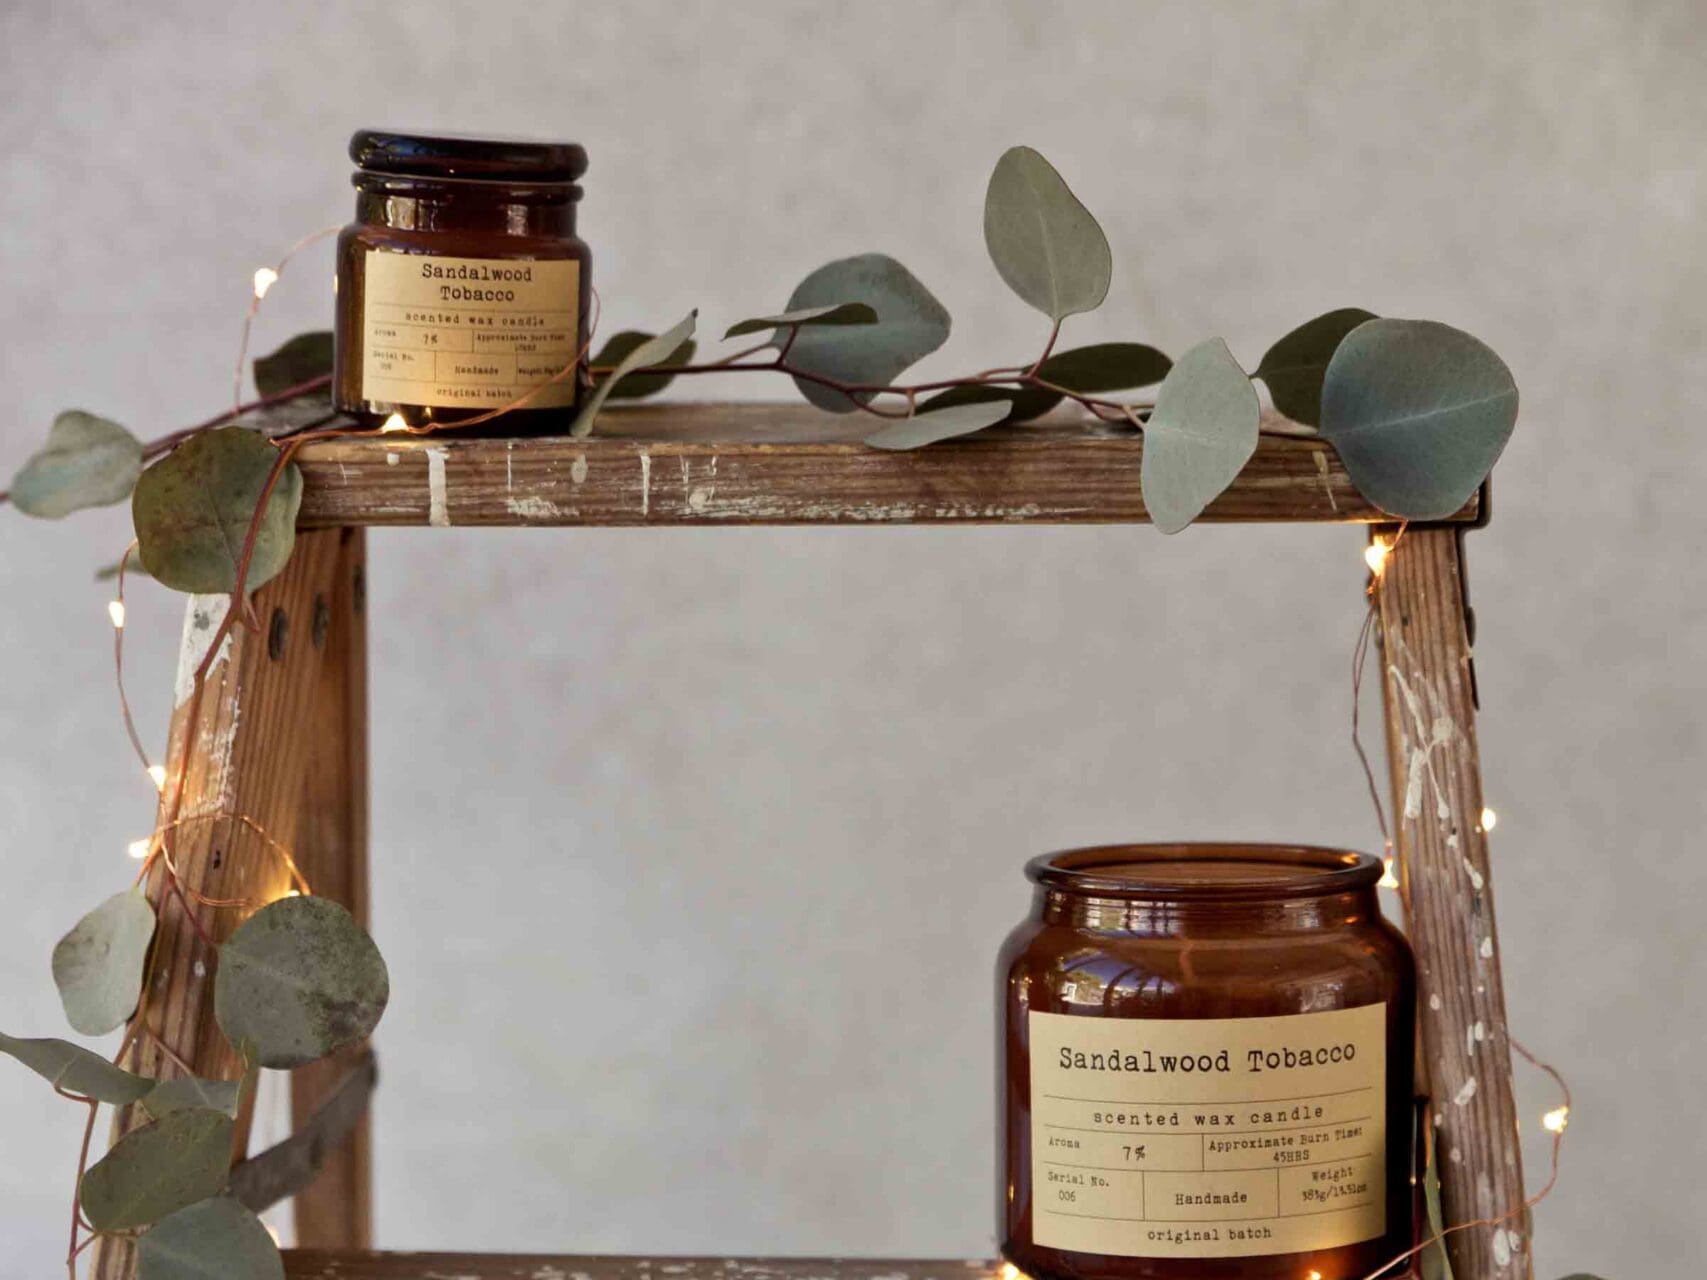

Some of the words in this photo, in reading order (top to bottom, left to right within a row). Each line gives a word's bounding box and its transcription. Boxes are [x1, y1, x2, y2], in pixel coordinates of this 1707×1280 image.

[422, 263, 532, 282] Sandalwood
[440, 286, 515, 301] Tobacco
[405, 312, 459, 324] scented
[469, 316, 493, 326] wax
[502, 315, 544, 327] candle
[1059, 1046, 1231, 1073] Sandalwood
[1247, 1042, 1356, 1073] Tobacco
[1094, 1111, 1180, 1127] scented
[1195, 1113, 1236, 1126] wax
[1250, 1106, 1324, 1124] candle
[1048, 1137, 1080, 1149] Aroma
[1208, 1135, 1294, 1153] Approximate
[1300, 1133, 1330, 1146] Burn
[1122, 1145, 1146, 1161] 7%
[1272, 1149, 1310, 1164] 45HRS
[1048, 1170, 1085, 1186] Serial
[1091, 1175, 1110, 1187] No.
[1312, 1166, 1354, 1182] Weight
[1174, 1191, 1248, 1207] Handmade
[1147, 1228, 1220, 1245] original
[1229, 1225, 1272, 1241] batch
